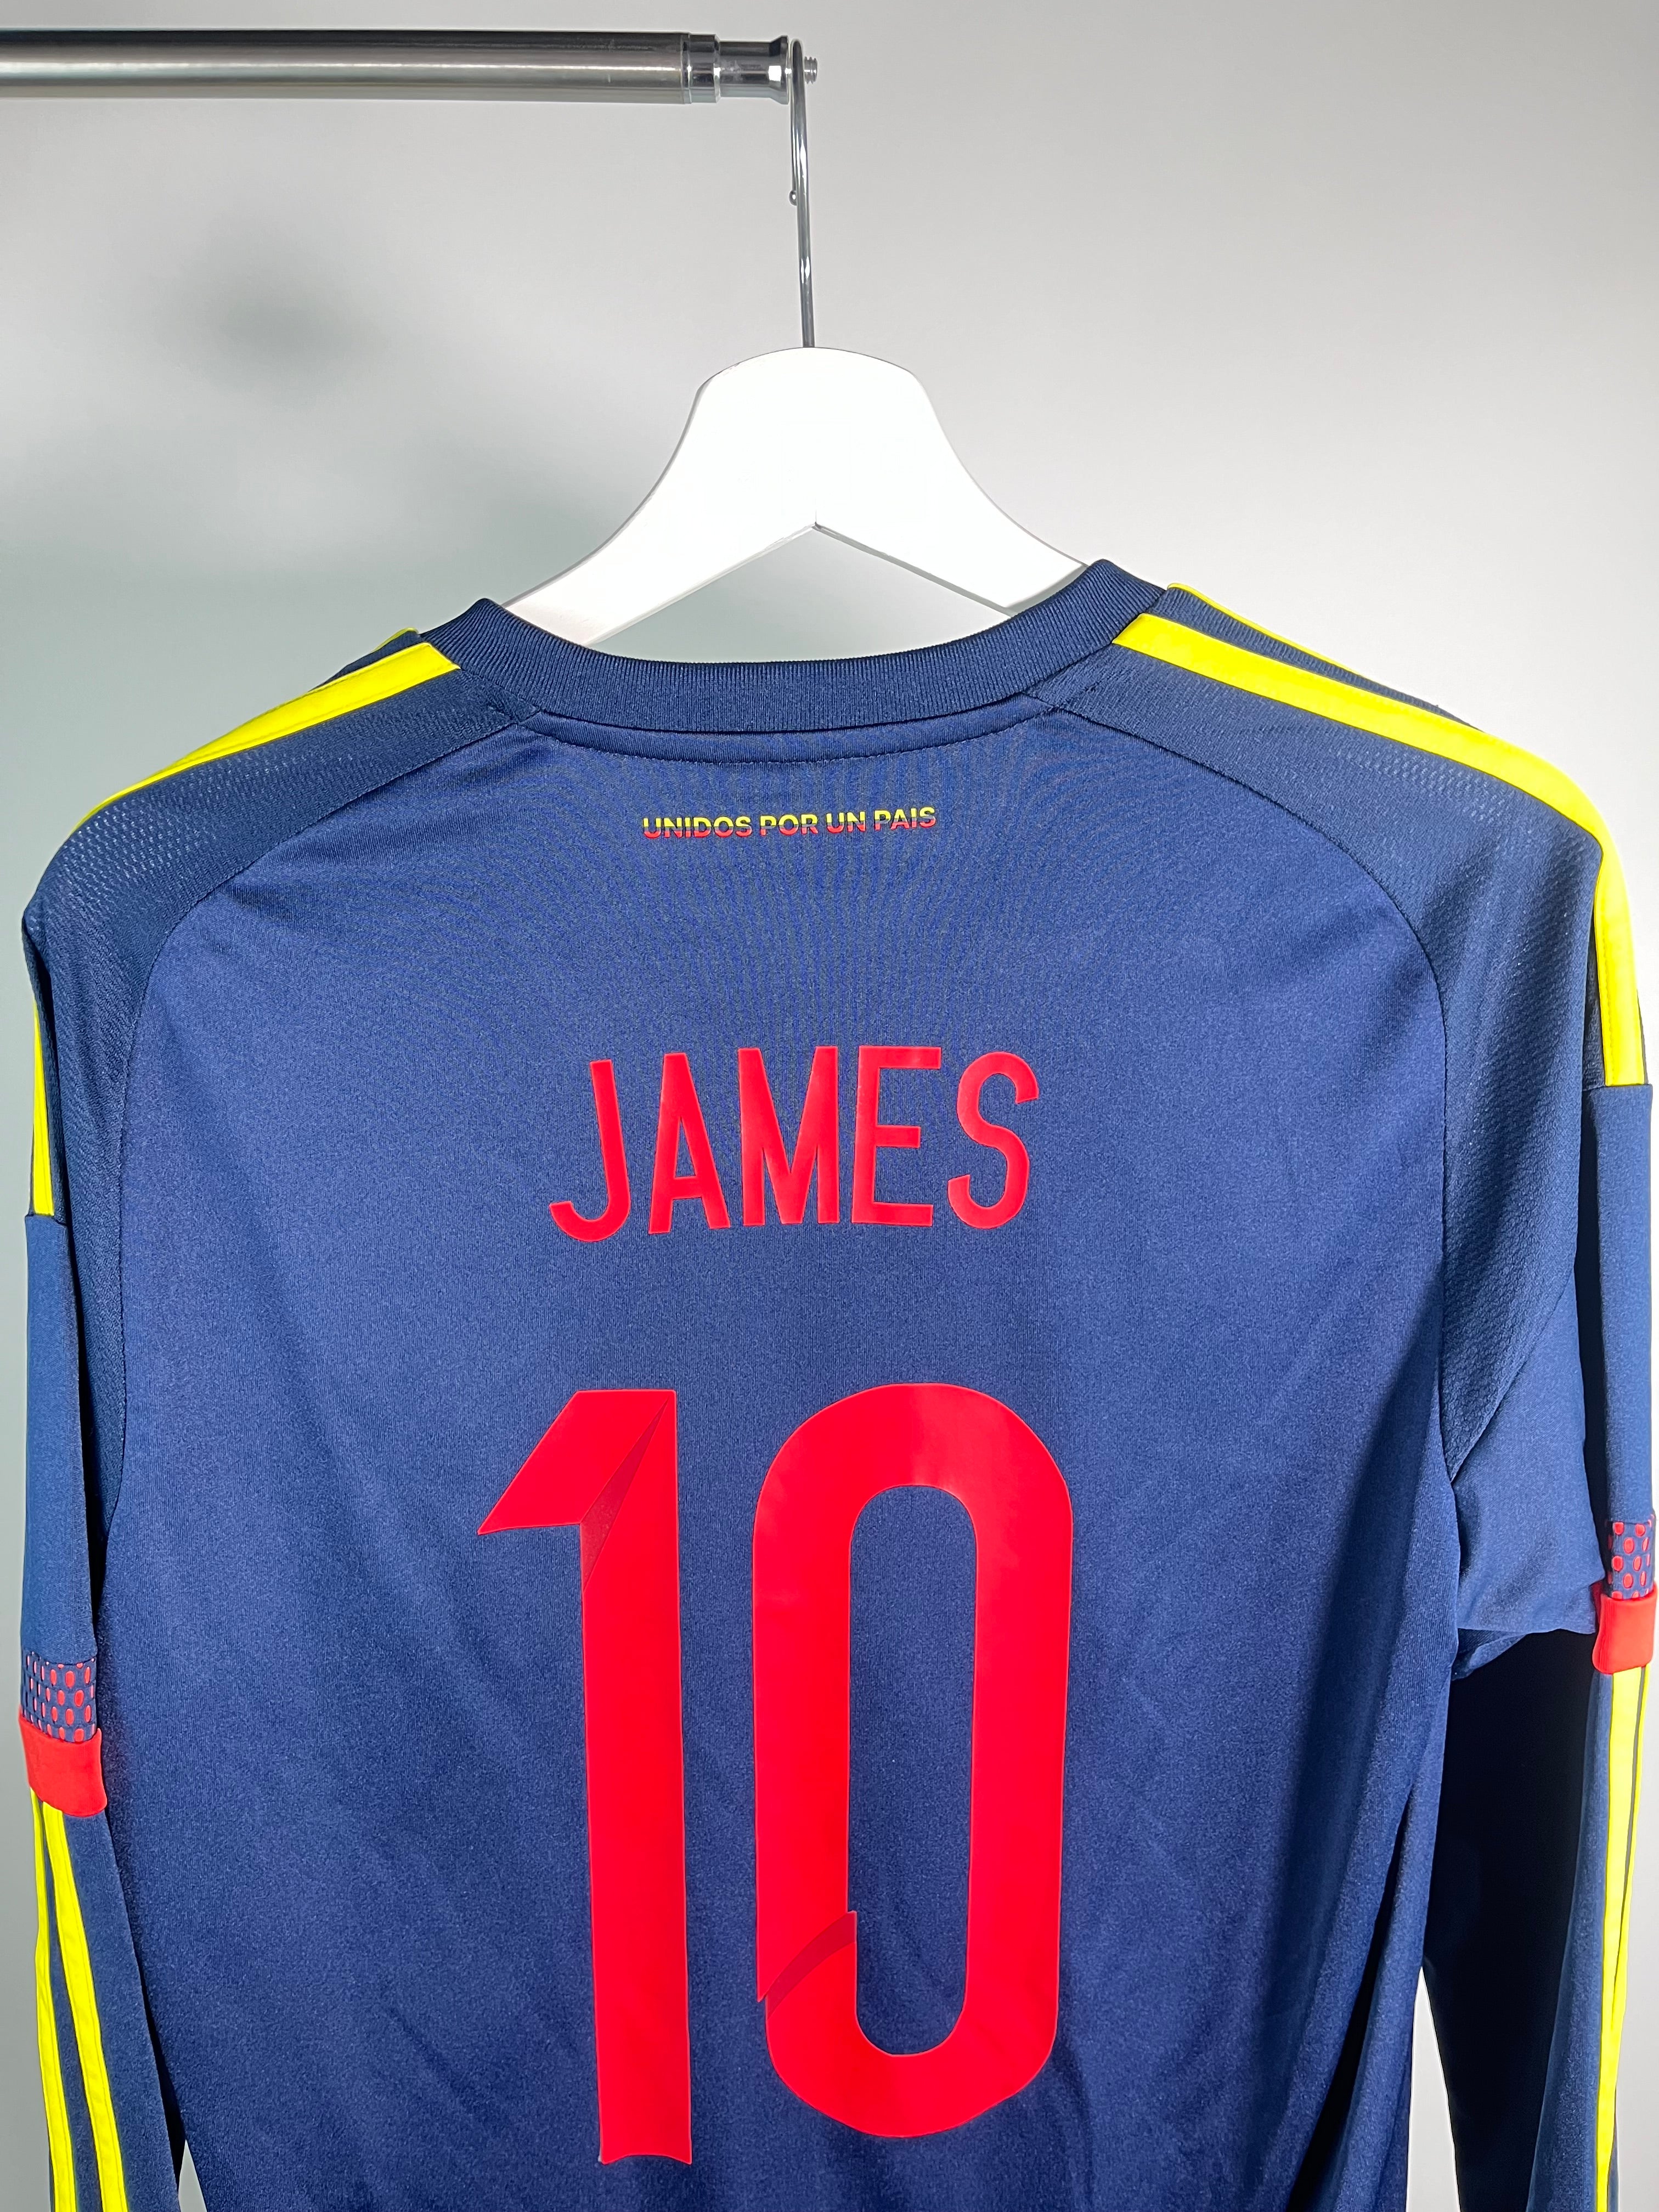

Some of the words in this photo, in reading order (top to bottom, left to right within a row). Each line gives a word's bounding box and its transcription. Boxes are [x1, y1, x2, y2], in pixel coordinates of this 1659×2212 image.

[642, 816, 753, 839] UNIDOS
[759, 814, 820, 836] POR
[826, 811, 867, 834] UN
[873, 806, 937, 831] PAIS
[549, 1046, 1040, 1243] JAMES
[478, 1383, 1074, 2165] 10
